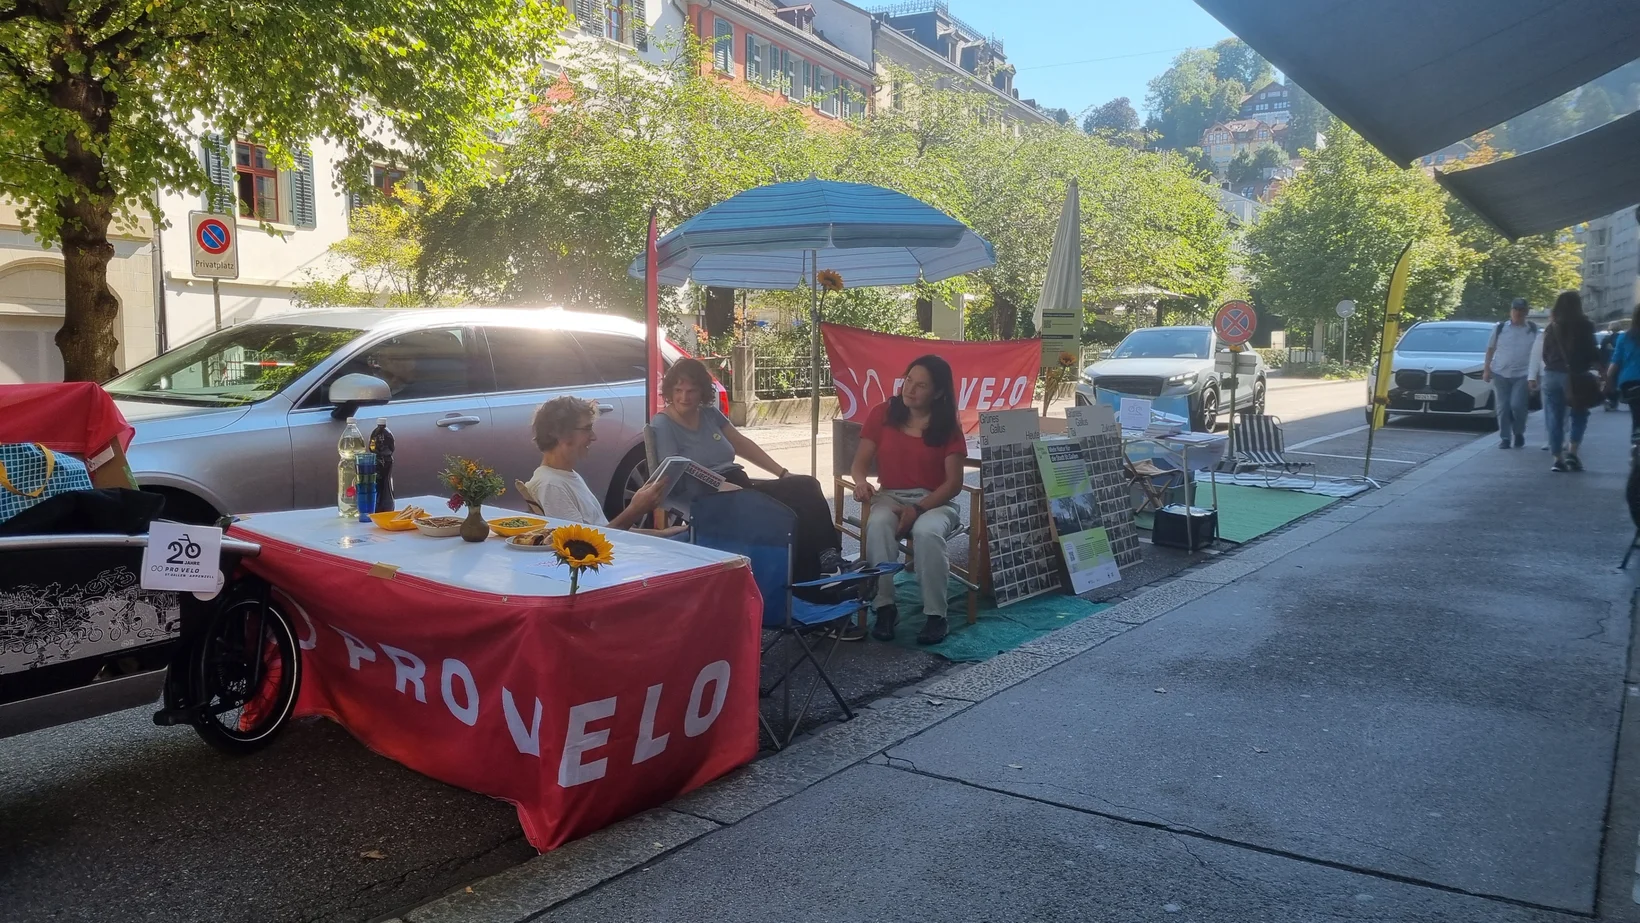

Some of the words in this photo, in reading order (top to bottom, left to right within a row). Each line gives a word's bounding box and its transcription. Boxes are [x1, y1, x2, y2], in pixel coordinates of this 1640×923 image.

[196, 259, 234, 270] Privatplatz
[958, 376, 1028, 411] VELO
[990, 423, 1006, 434] Gallus
[1025, 431, 1040, 440] Heute
[166, 541, 202, 565] 20
[329, 624, 480, 727] PRO
[502, 659, 731, 788] VELO
